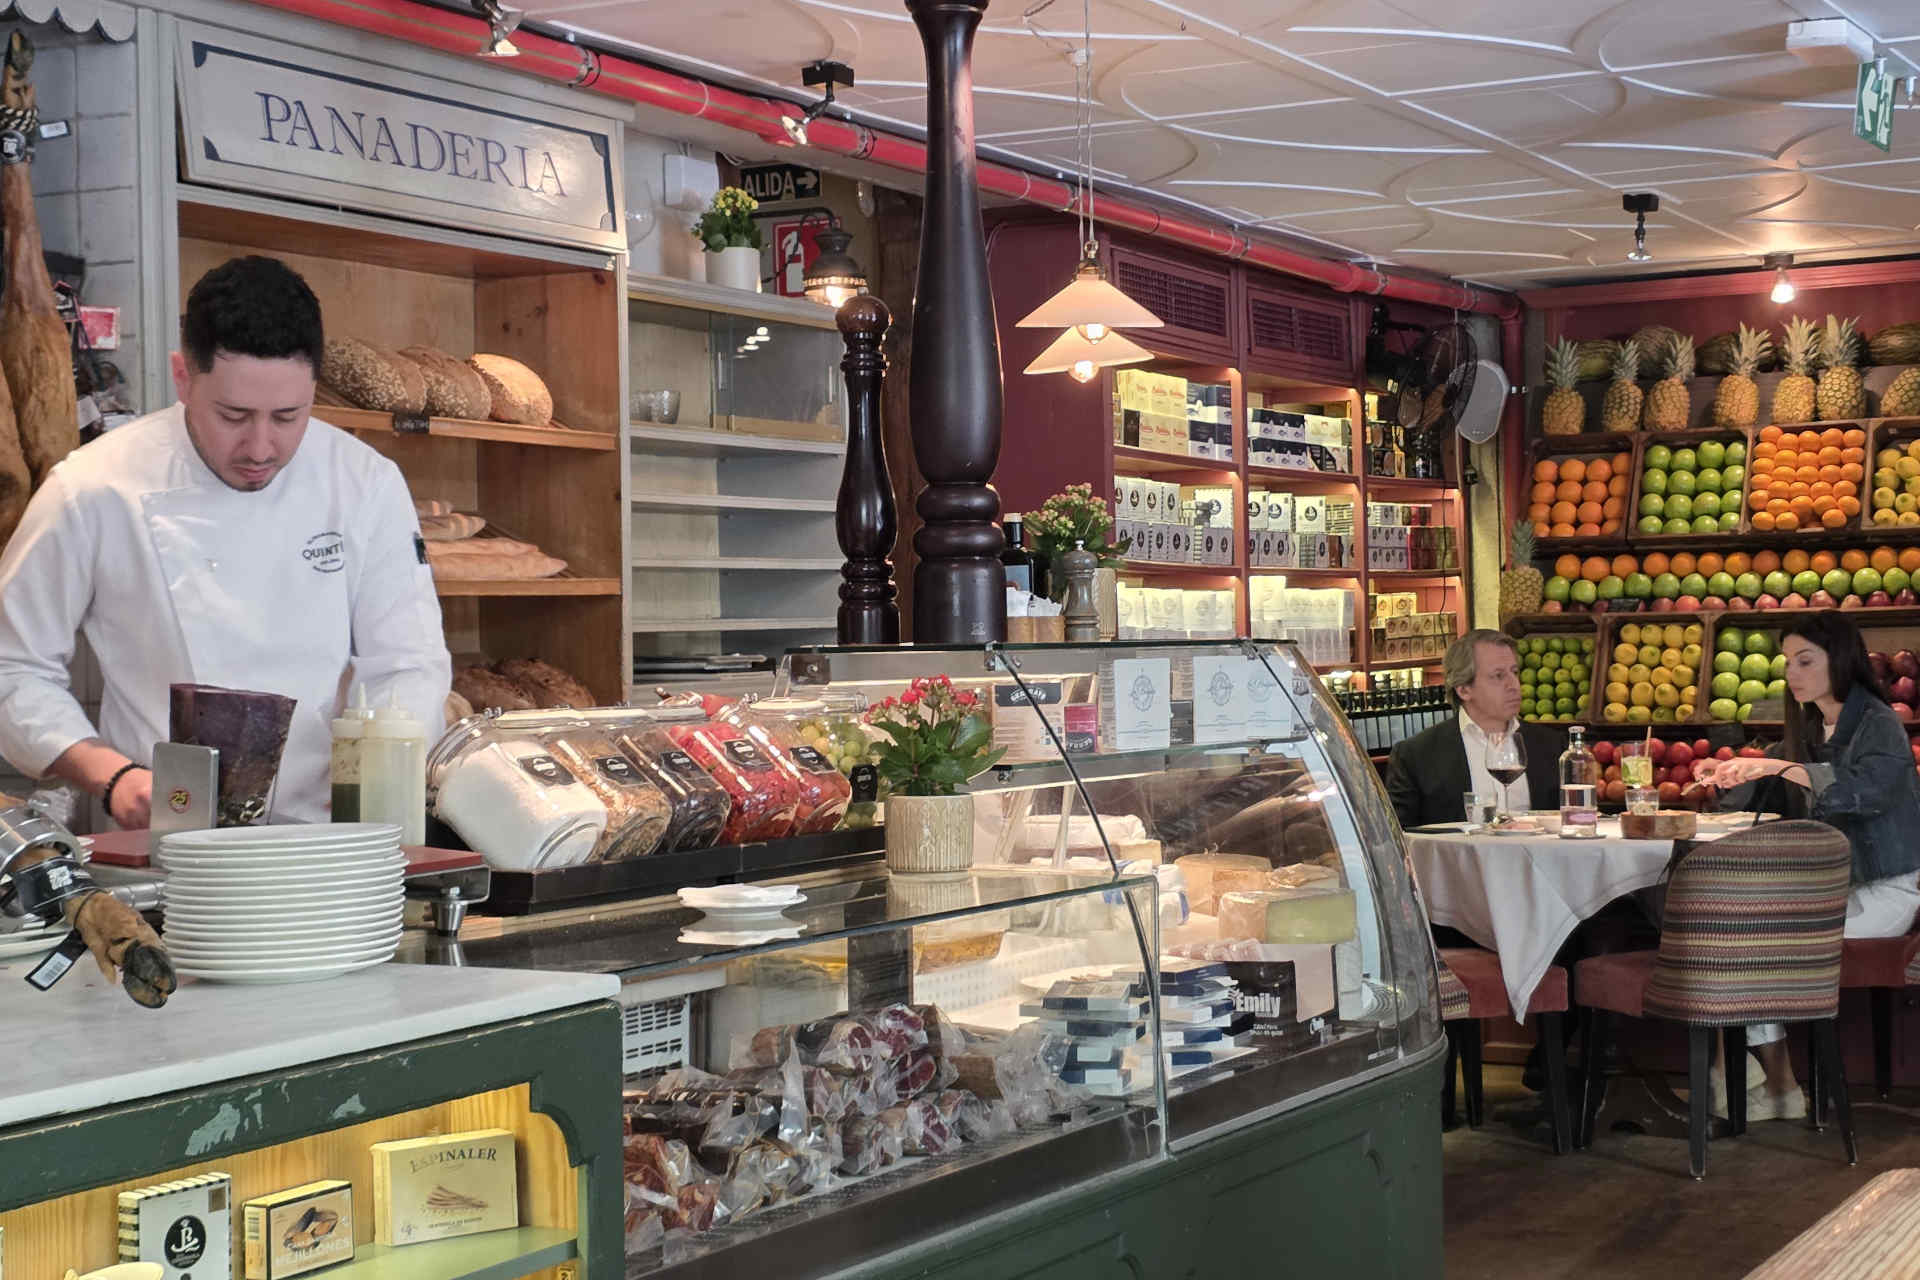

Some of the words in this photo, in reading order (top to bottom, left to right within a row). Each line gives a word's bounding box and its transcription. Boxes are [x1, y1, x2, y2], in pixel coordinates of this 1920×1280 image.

[255, 90, 568, 198] PANADERIA
[743, 170, 796, 198] ALIDA
[1235, 992, 1281, 1018] Emily
